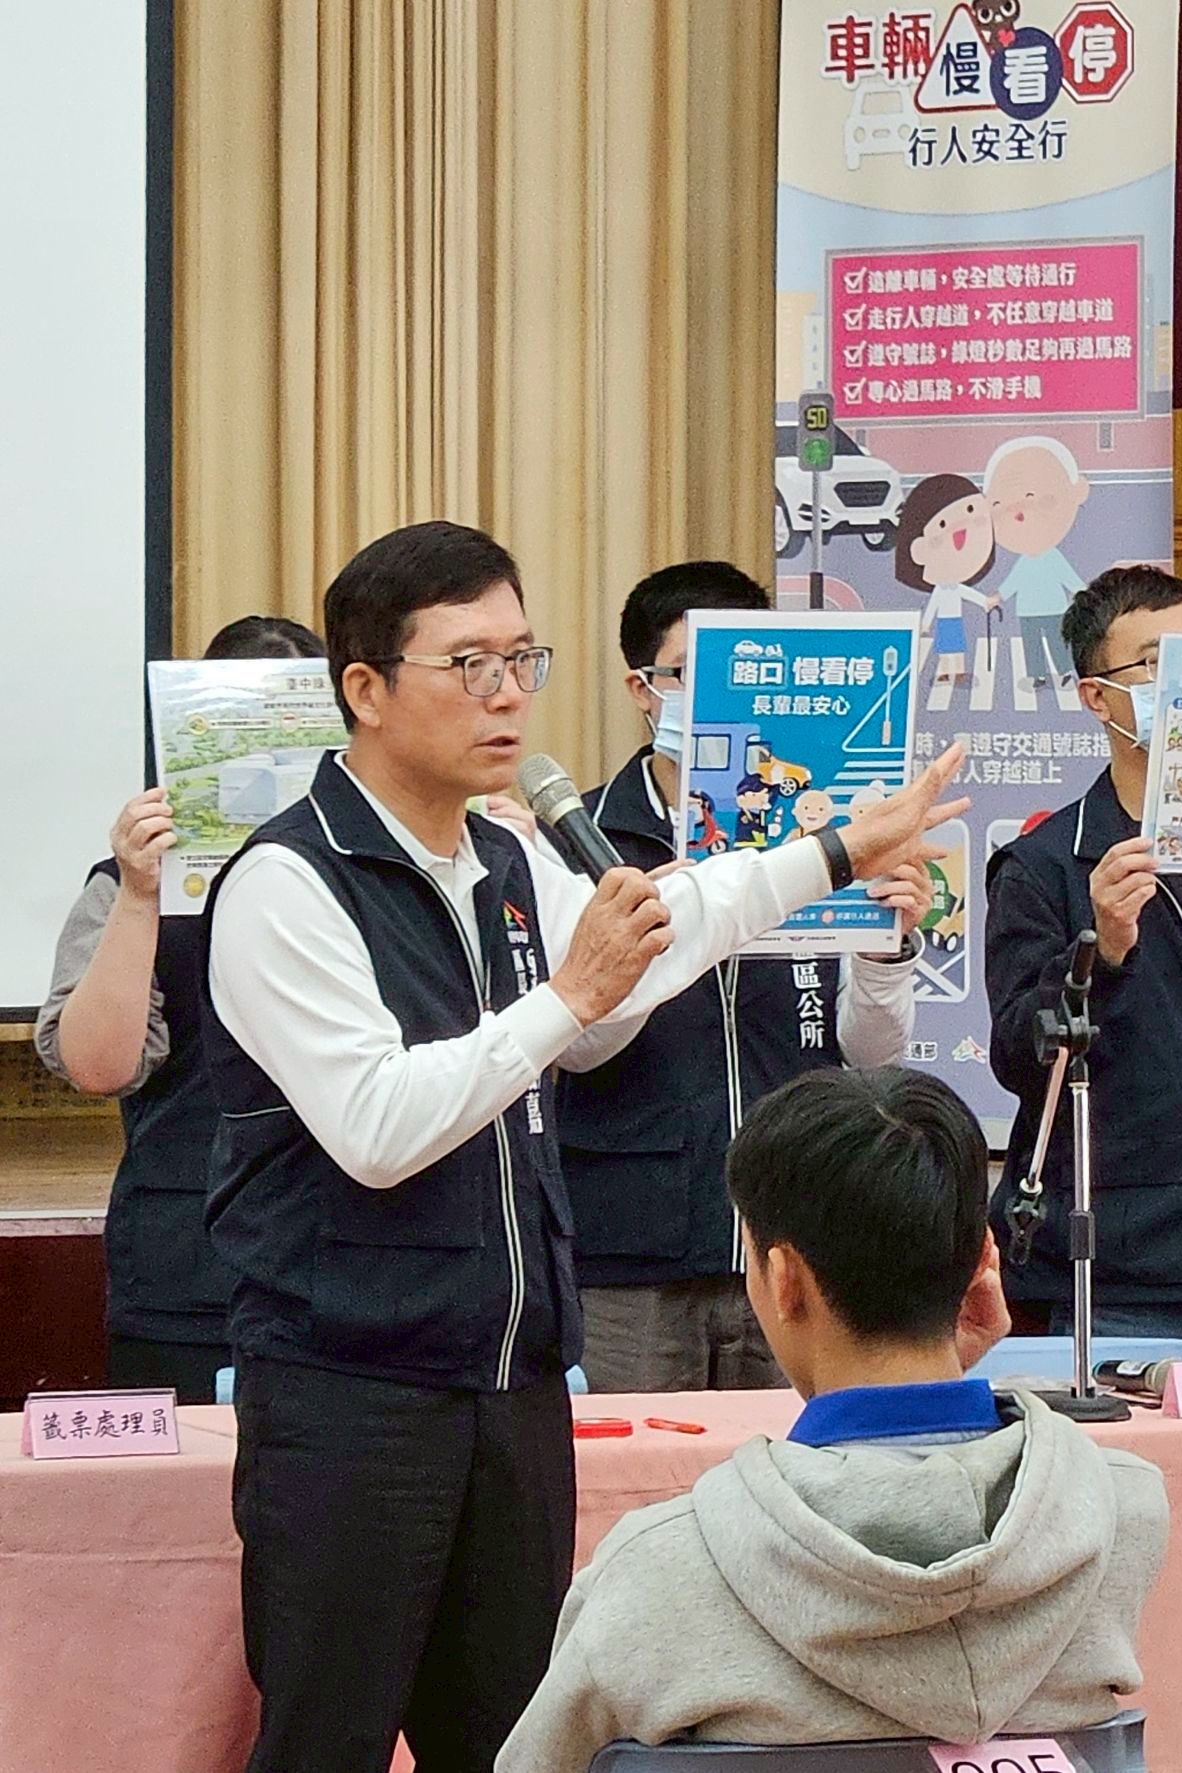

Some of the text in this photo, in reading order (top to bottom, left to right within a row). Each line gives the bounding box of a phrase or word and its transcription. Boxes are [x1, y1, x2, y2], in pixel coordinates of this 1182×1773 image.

[908, 120, 1068, 166] 行人安全行
[867, 298, 1114, 331] 走行人穿越道，不任意穿越車道
[867, 375, 1042, 403] 專心過馬路，不滑手機
[733, 656, 875, 686] 路口 慢看停
[751, 695, 851, 717] 長輩最安心
[792, 961, 825, 1049] 區公所
